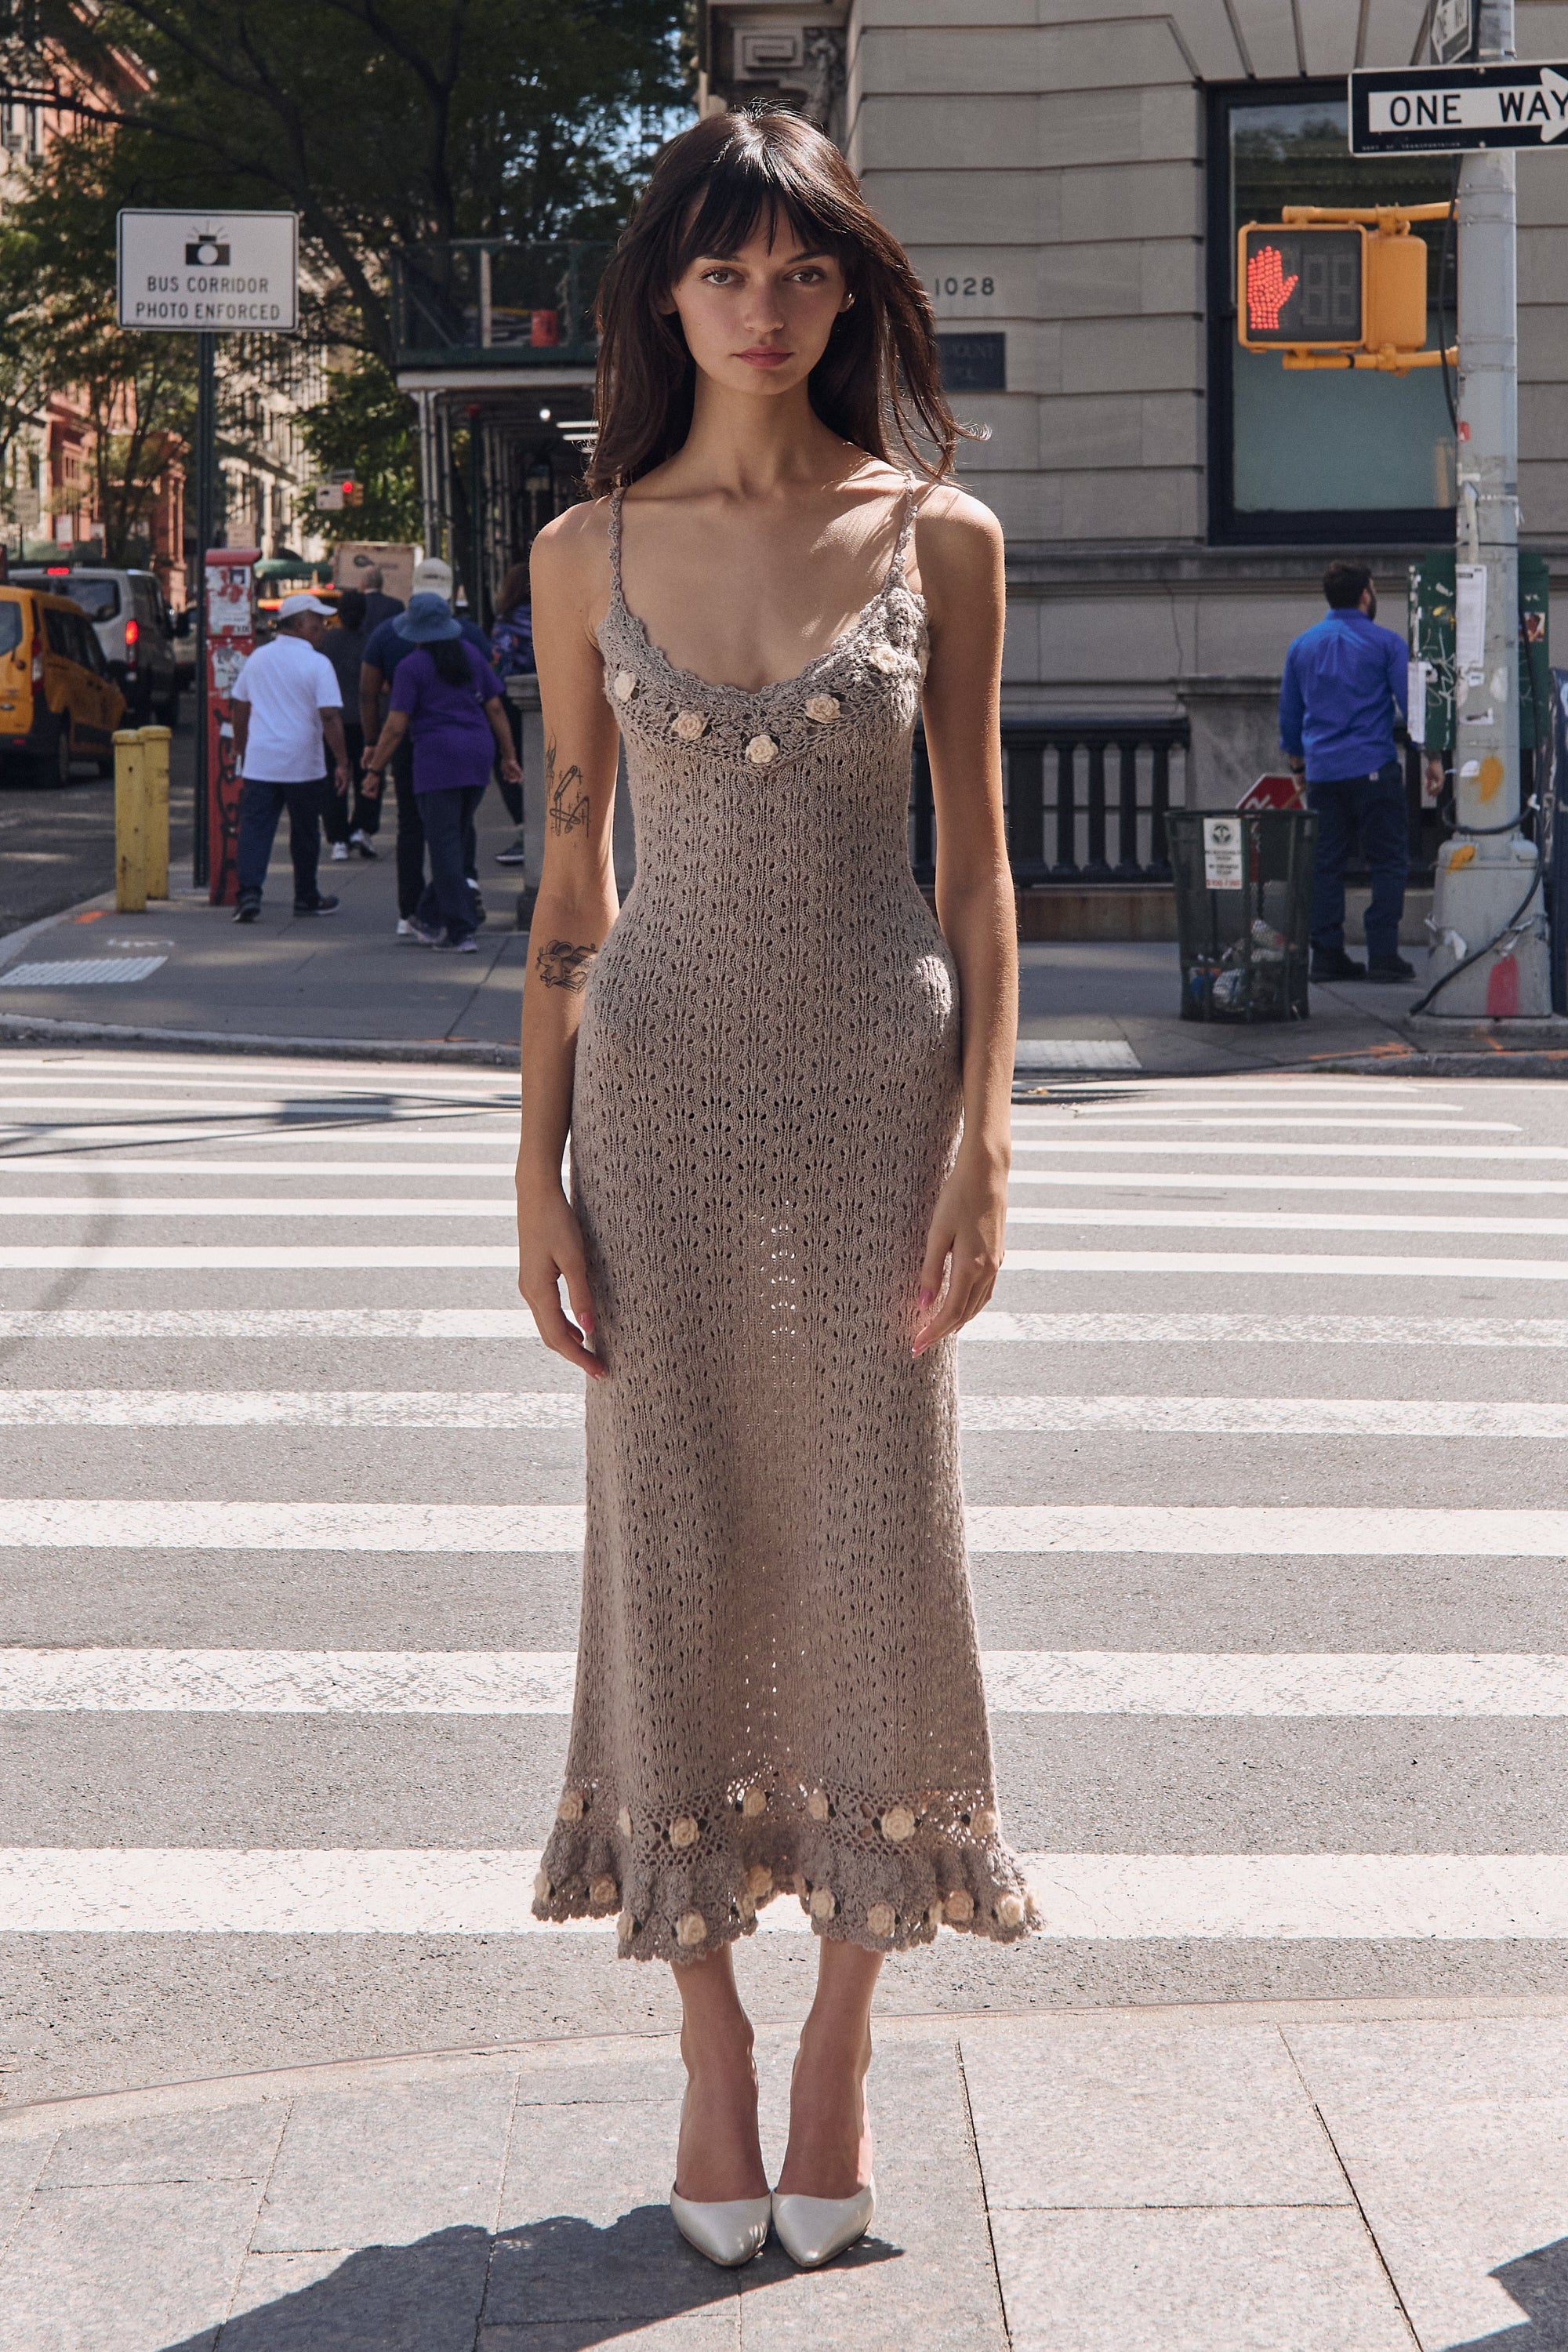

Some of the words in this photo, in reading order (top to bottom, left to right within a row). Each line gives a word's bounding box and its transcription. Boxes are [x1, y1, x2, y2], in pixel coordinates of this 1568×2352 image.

[1390, 94, 1461, 126] ONE
[1499, 90, 1568, 122] WAY
[147, 276, 180, 292] BUS
[187, 276, 268, 293] CORRIDOR
[935, 277, 994, 296] 1028
[136, 302, 188, 318] PHOTO
[195, 303, 280, 320] ENFORCED
